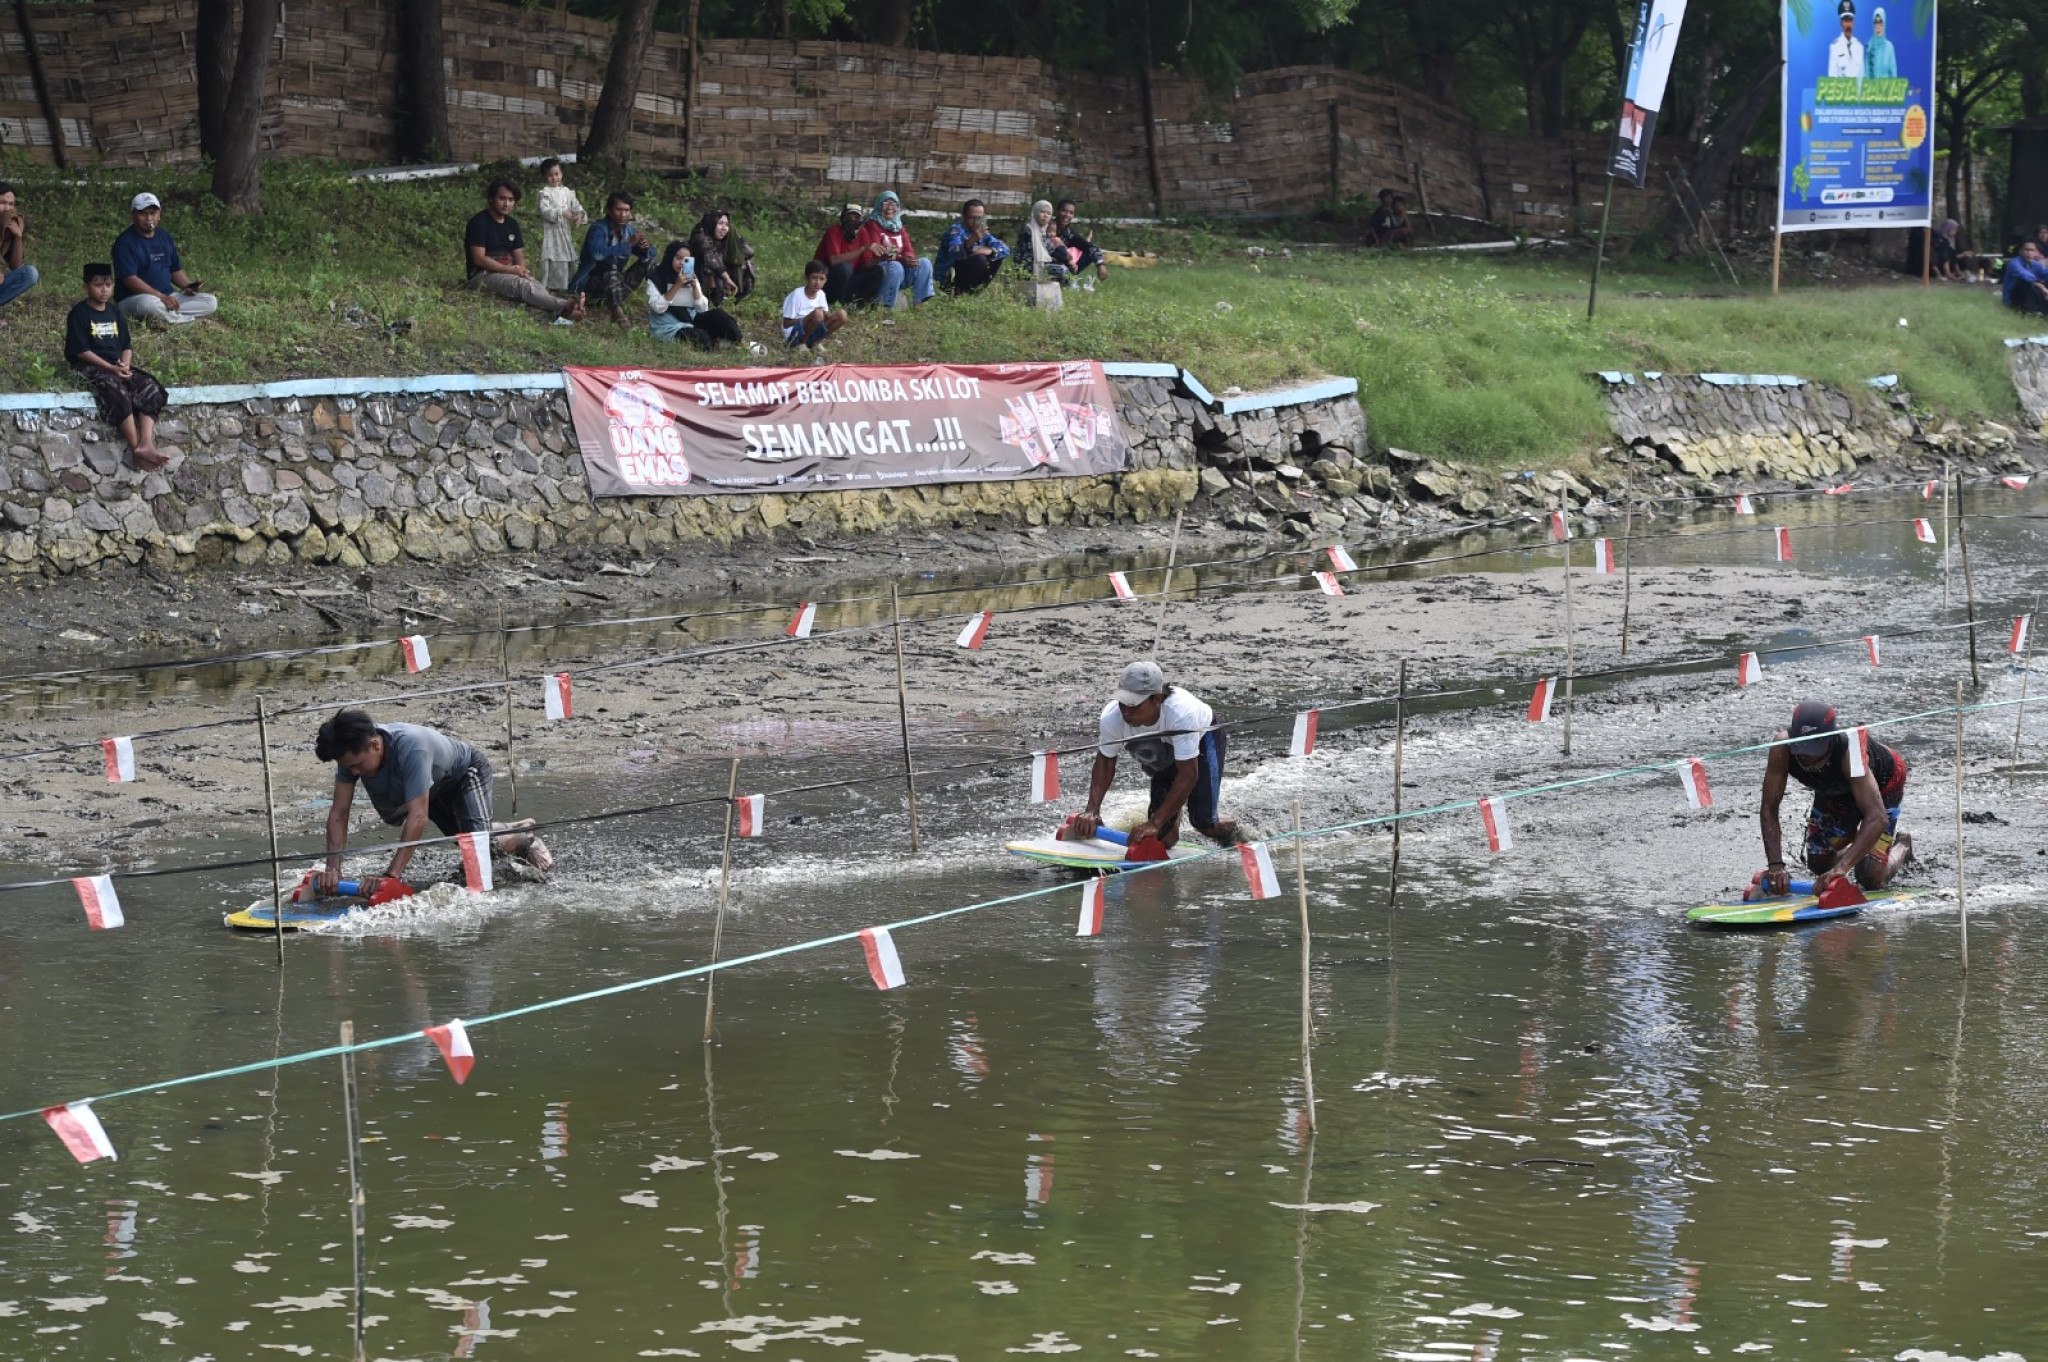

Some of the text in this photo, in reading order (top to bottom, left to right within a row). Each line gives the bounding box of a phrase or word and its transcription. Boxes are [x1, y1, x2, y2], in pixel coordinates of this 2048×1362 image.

[1816, 78, 1908, 101] PESTA RAKYAT
[618, 370, 643, 380] KOPI
[694, 382, 790, 407] SELAMAT
[795, 378, 908, 405] BERLOMBA
[908, 376, 945, 402] SKI
[946, 377, 981, 400] LOT
[610, 425, 682, 456] UANG
[617, 455, 691, 484] EMAS
